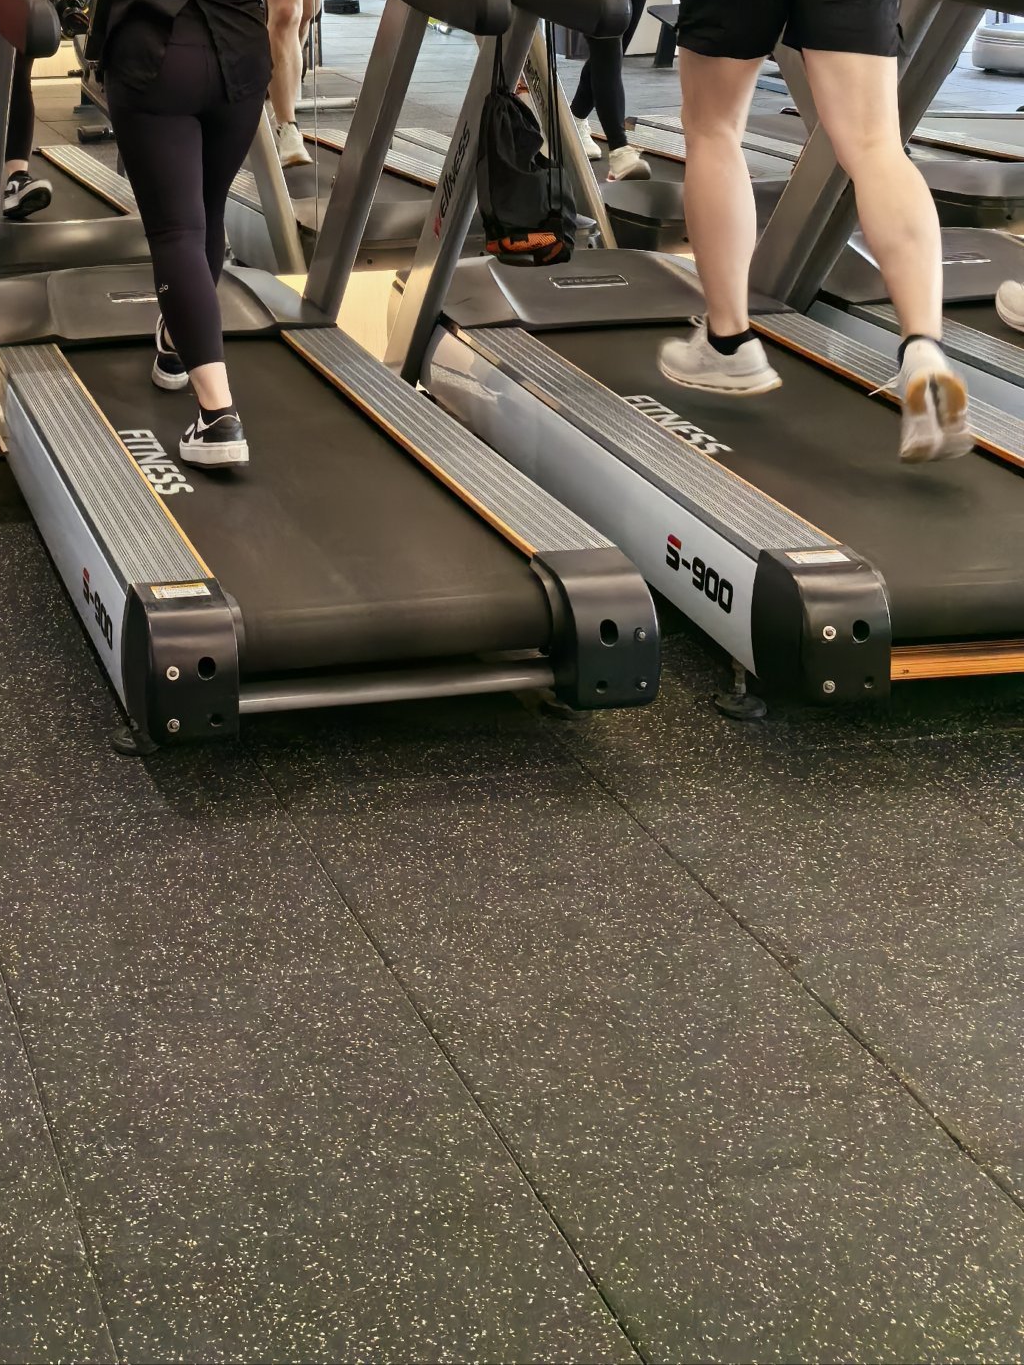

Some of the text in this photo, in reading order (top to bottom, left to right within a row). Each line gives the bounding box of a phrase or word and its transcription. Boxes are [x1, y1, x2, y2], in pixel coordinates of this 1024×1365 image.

[623, 395, 734, 454] FITNESS
[118, 429, 194, 495] FITNESS
[83, 568, 113, 650] S-900
[666, 534, 733, 614] S-900
